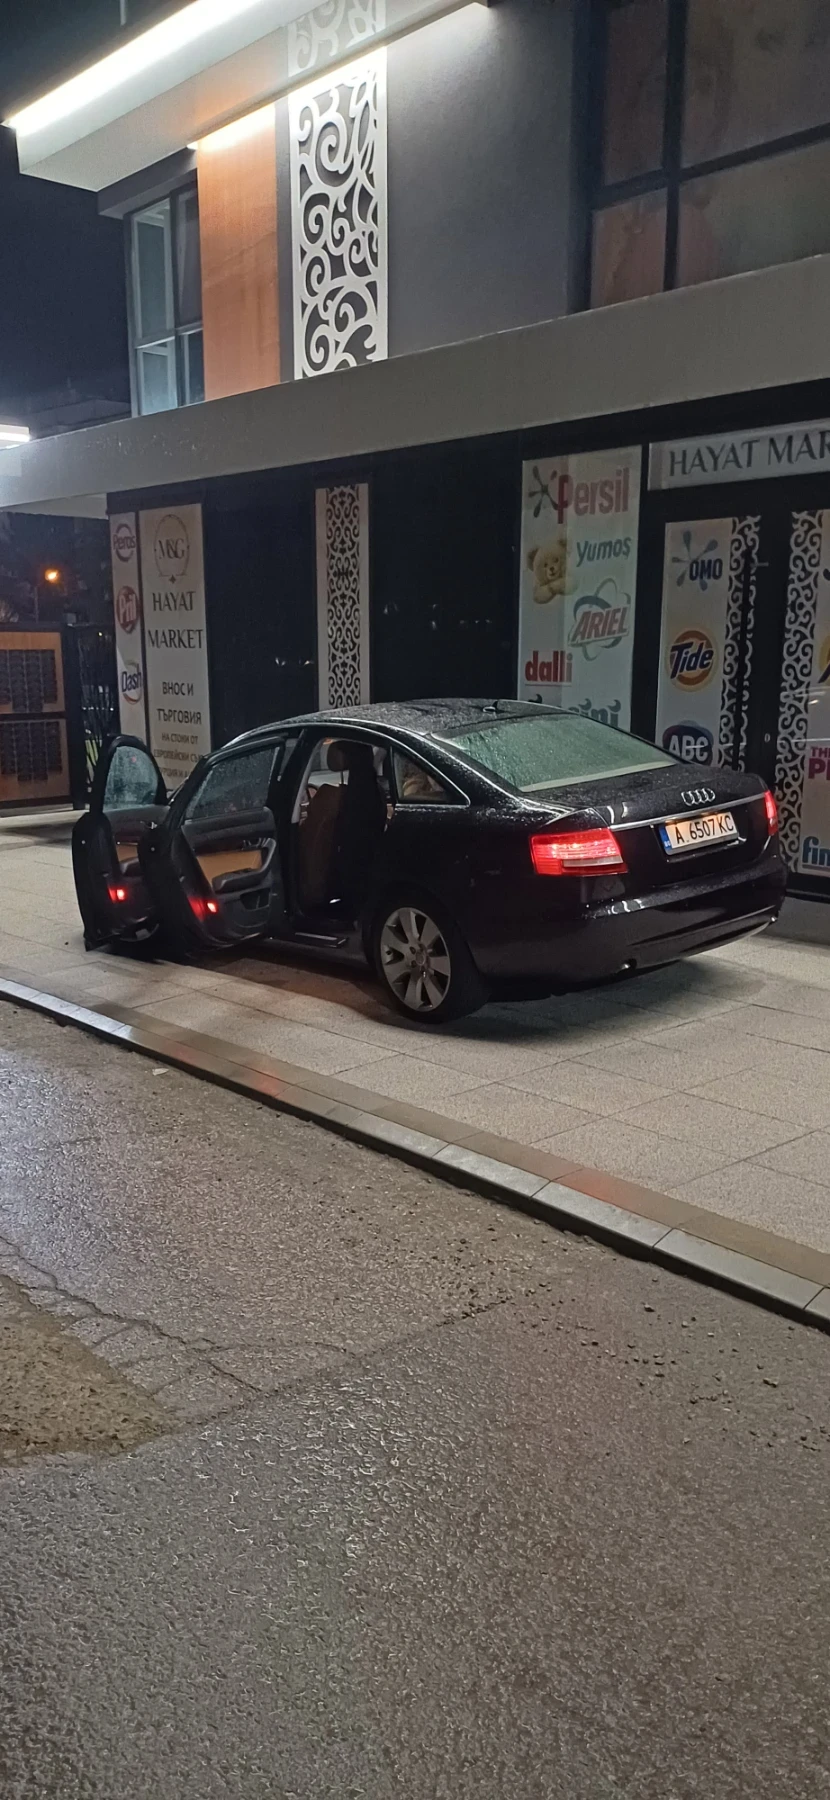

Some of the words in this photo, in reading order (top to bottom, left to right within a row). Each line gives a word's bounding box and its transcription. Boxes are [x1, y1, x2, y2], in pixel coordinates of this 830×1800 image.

[668, 439, 760, 477] HAYAT
[557, 467, 630, 524] Persil
[689, 558, 723, 581] OMO
[152, 591, 195, 611] HAYAT
[570, 606, 629, 643] ARIEL
[148, 629, 204, 649] MARKET
[525, 650, 573, 683] dalli
[670, 641, 714, 680] Tide
[121, 668, 142, 693] Dash
[162, 681, 185, 696] ВНОС
[187, 682, 194, 697] И
[157, 708, 202, 725] ТЪРГОВИЯ
[668, 734, 709, 762] ABC
[689, 818, 716, 840] 6507
